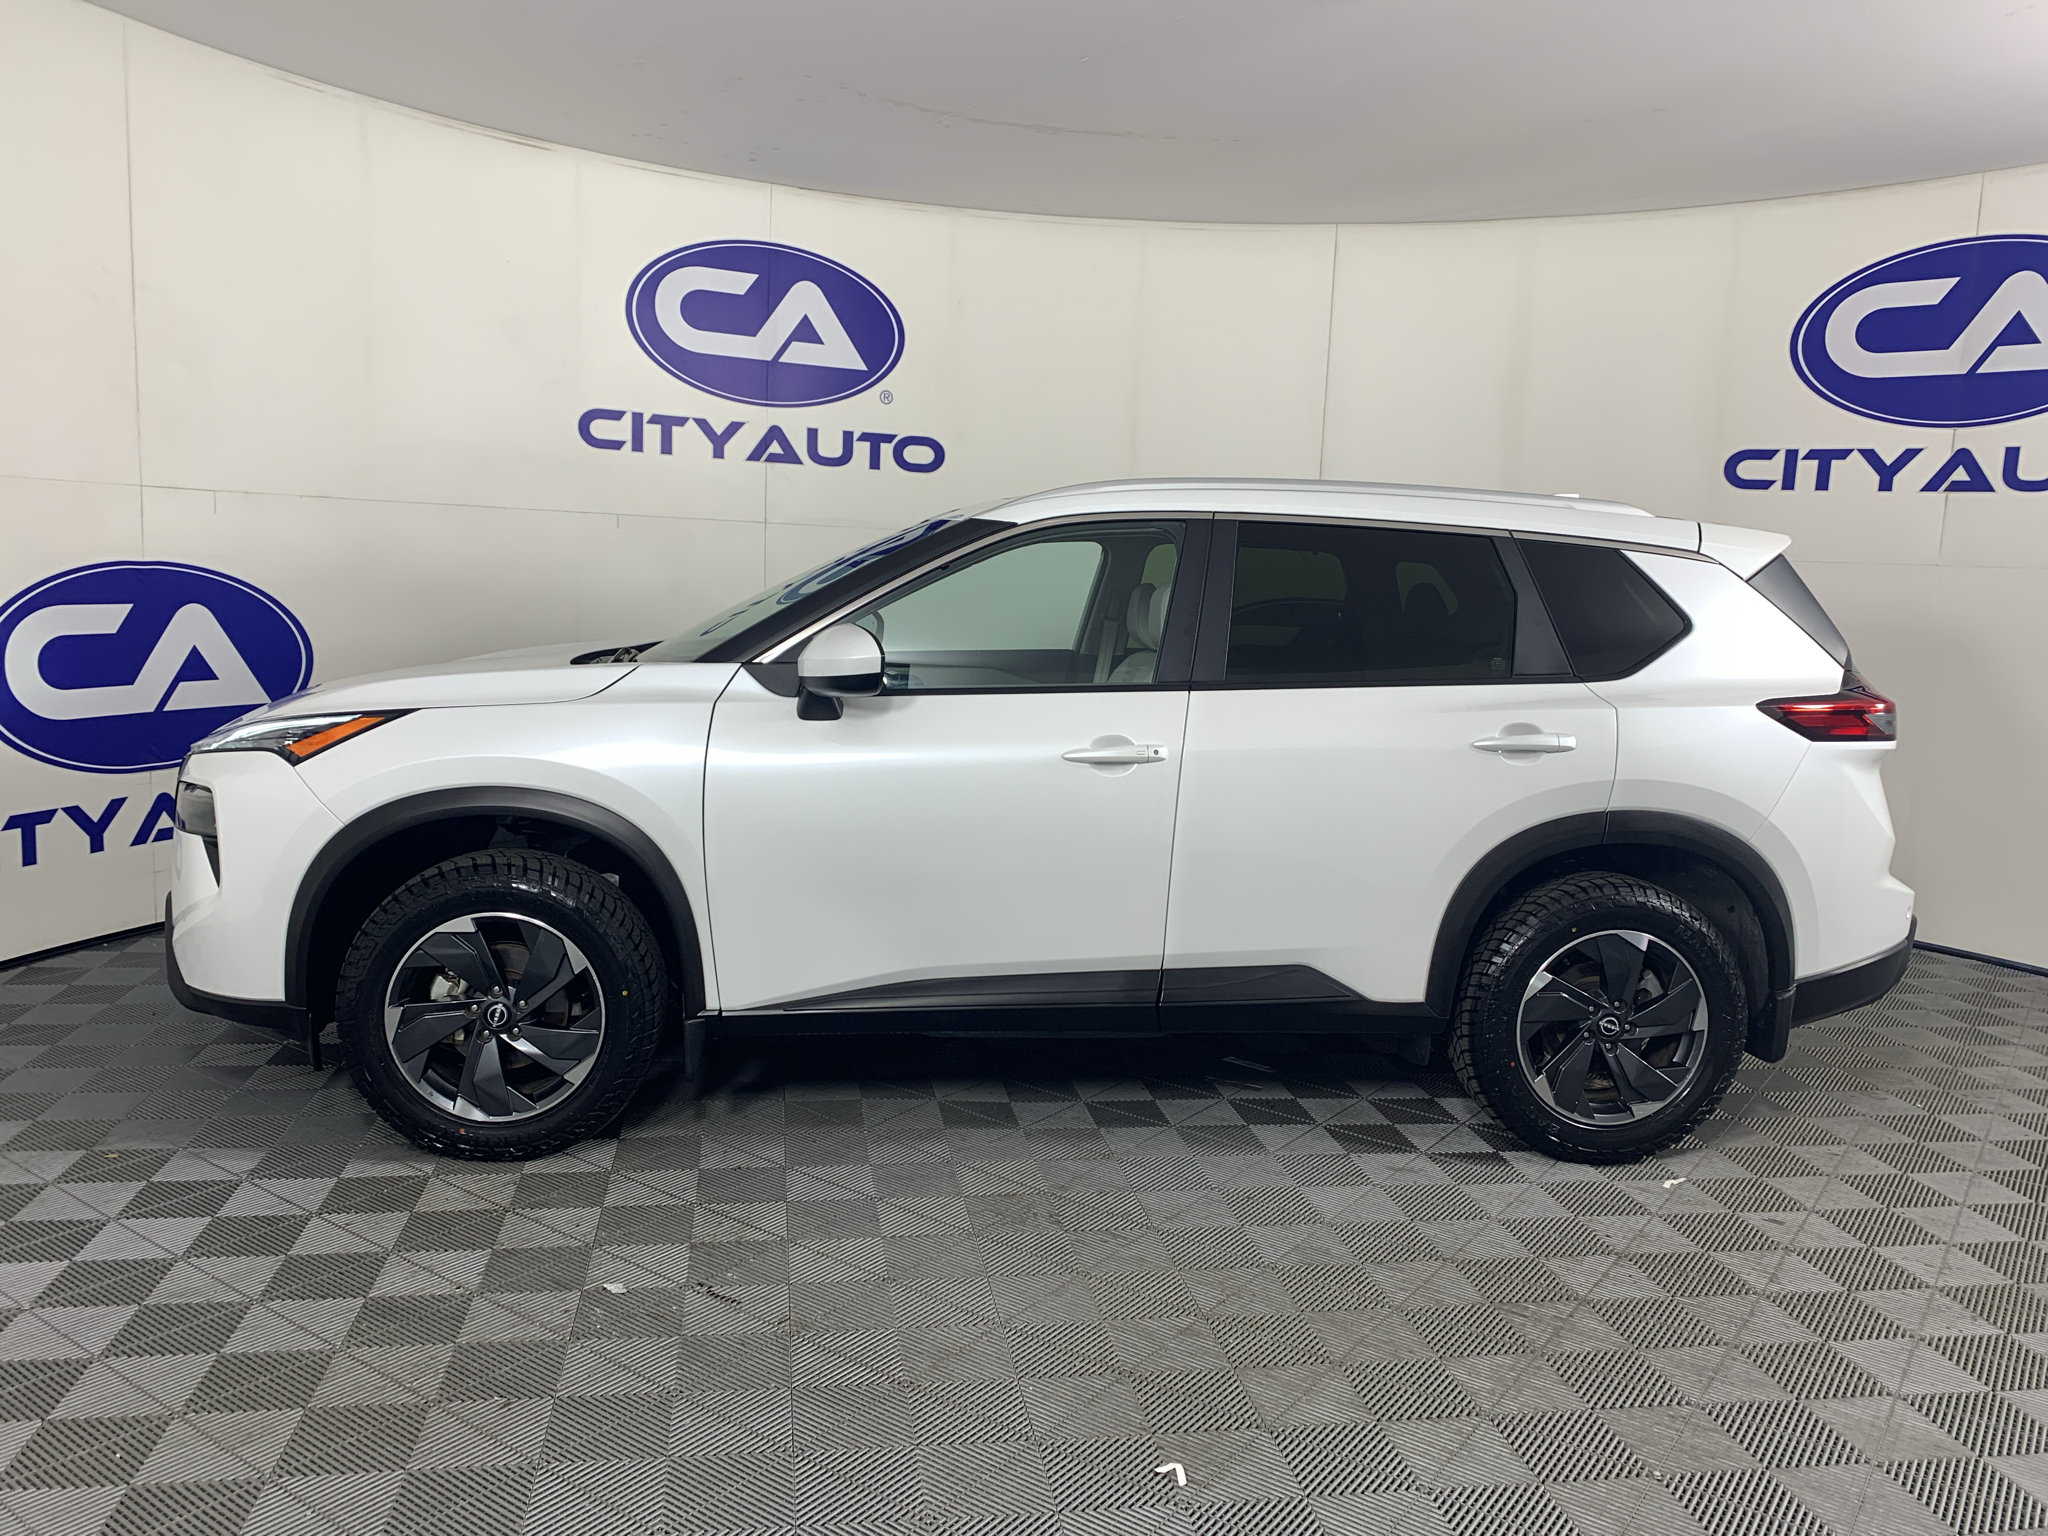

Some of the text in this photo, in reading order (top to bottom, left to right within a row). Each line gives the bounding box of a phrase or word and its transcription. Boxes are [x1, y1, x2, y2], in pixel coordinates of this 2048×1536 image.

[654, 265, 869, 372] CA
[1824, 269, 2048, 379] CA
[4, 602, 272, 721] CA
